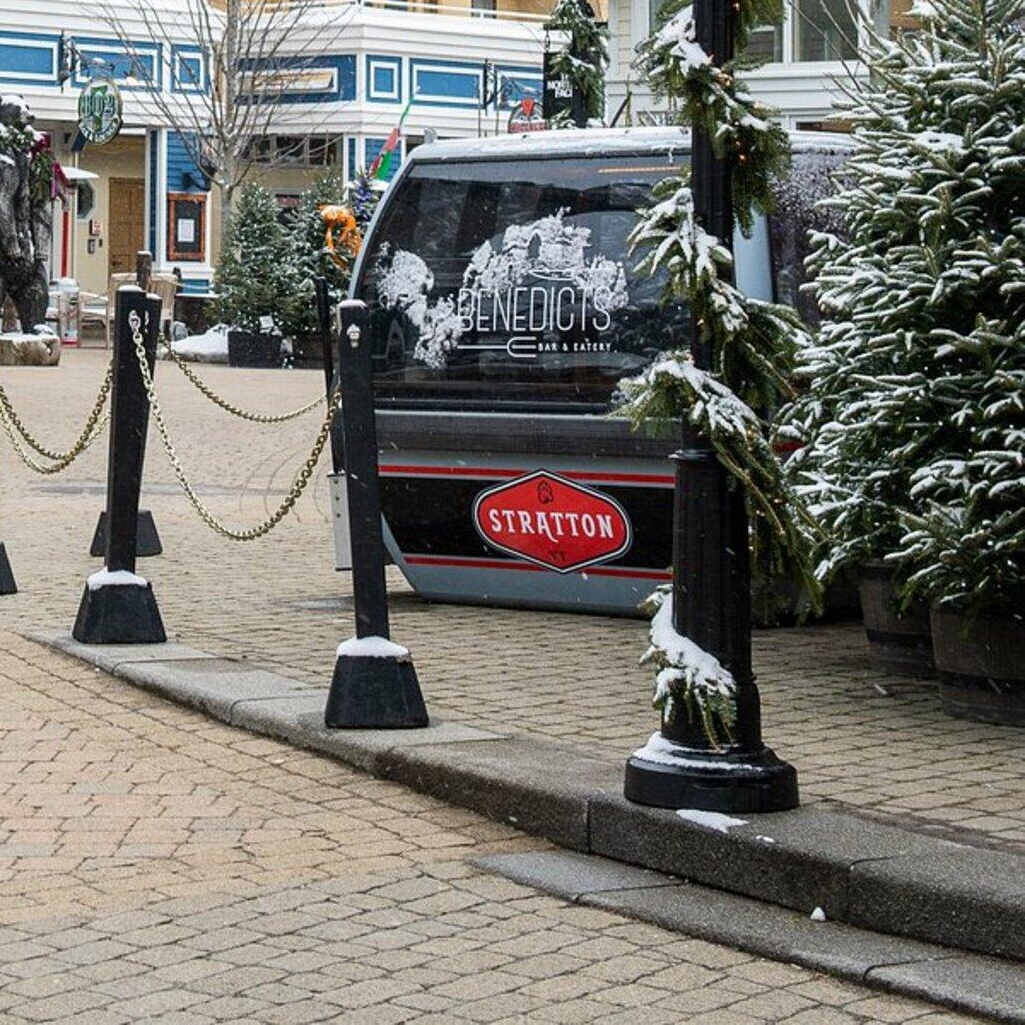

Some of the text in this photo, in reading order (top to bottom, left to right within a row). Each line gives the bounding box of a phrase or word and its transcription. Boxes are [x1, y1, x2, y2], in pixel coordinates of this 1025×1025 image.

[458, 286, 611, 332] BENEDICTS
[538, 342, 611, 352] BAR & EATERY
[488, 508, 614, 543] STRATTON
